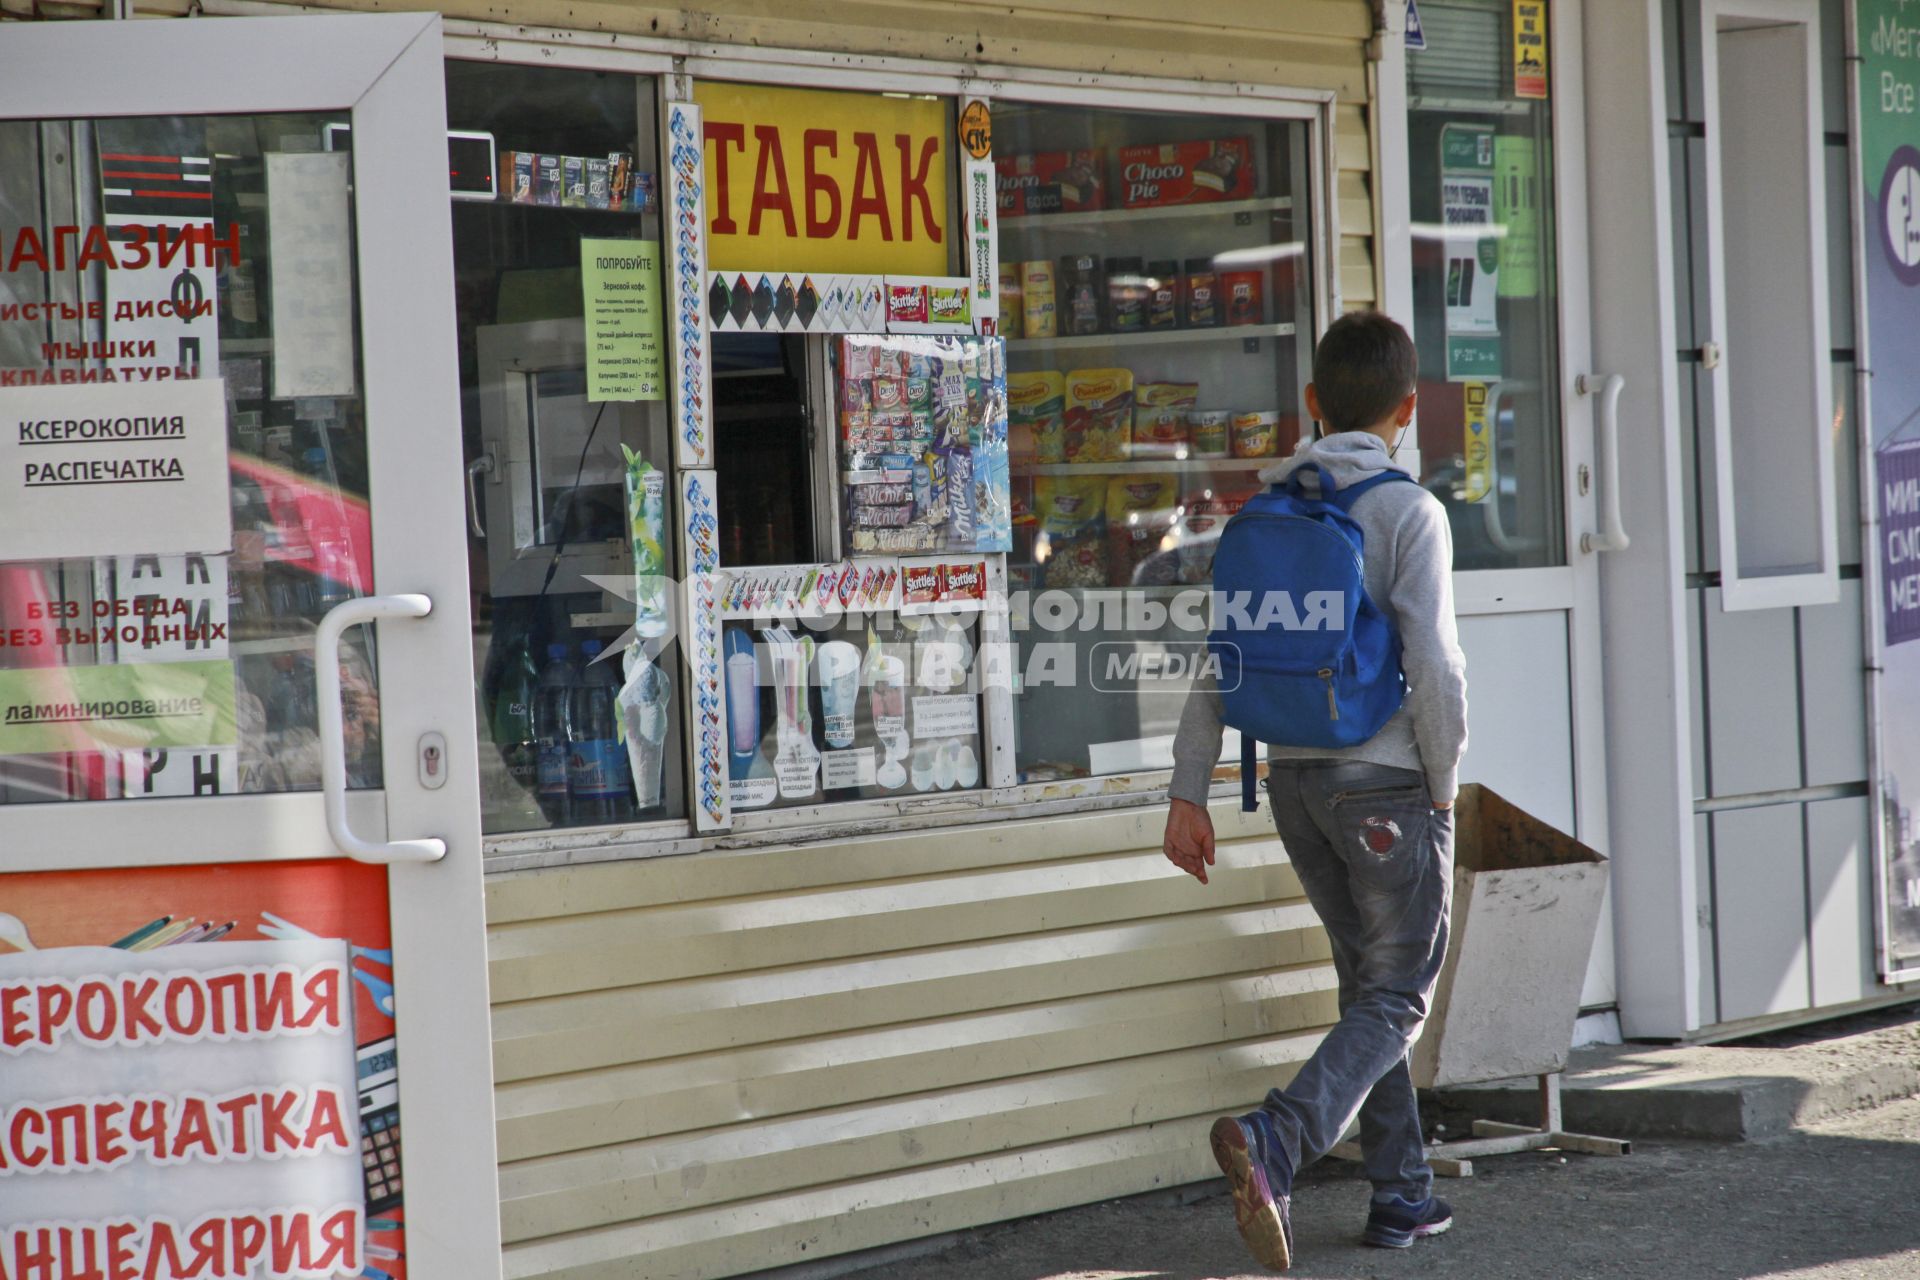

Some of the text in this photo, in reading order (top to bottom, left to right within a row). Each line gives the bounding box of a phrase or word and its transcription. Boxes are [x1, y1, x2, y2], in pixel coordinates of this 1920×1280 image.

[1881, 70, 1914, 113] Все
[703, 121, 943, 244] ТАБАК
[996, 174, 1040, 190] hoco
[1124, 163, 1184, 182] Choco
[0, 223, 241, 272] АГАЗИН
[596, 256, 652, 271] ПОПРОБУЙТЕ
[114, 299, 213, 321] ДИСКИ
[889, 295, 921, 309] Skittles
[931, 296, 963, 311] Skittles
[41, 340, 157, 360] МЫШКИ
[19, 416, 185, 440] КСЕРОКОПИЯ
[25, 458, 184, 482] РАСПЕЧАТКА
[906, 577, 936, 592] Skittles
[948, 571, 978, 590] Skittles
[1890, 573, 1920, 613] МЕ
[27, 597, 190, 620] БЕЗ ОБЕДА
[56, 622, 228, 645] ВЫХОДНЫХ
[6, 695, 203, 721] ламинирование
[0, 1090, 349, 1169] СПЕЧАТКА
[0, 1209, 357, 1280] НЦЕЛЯРИЯ
